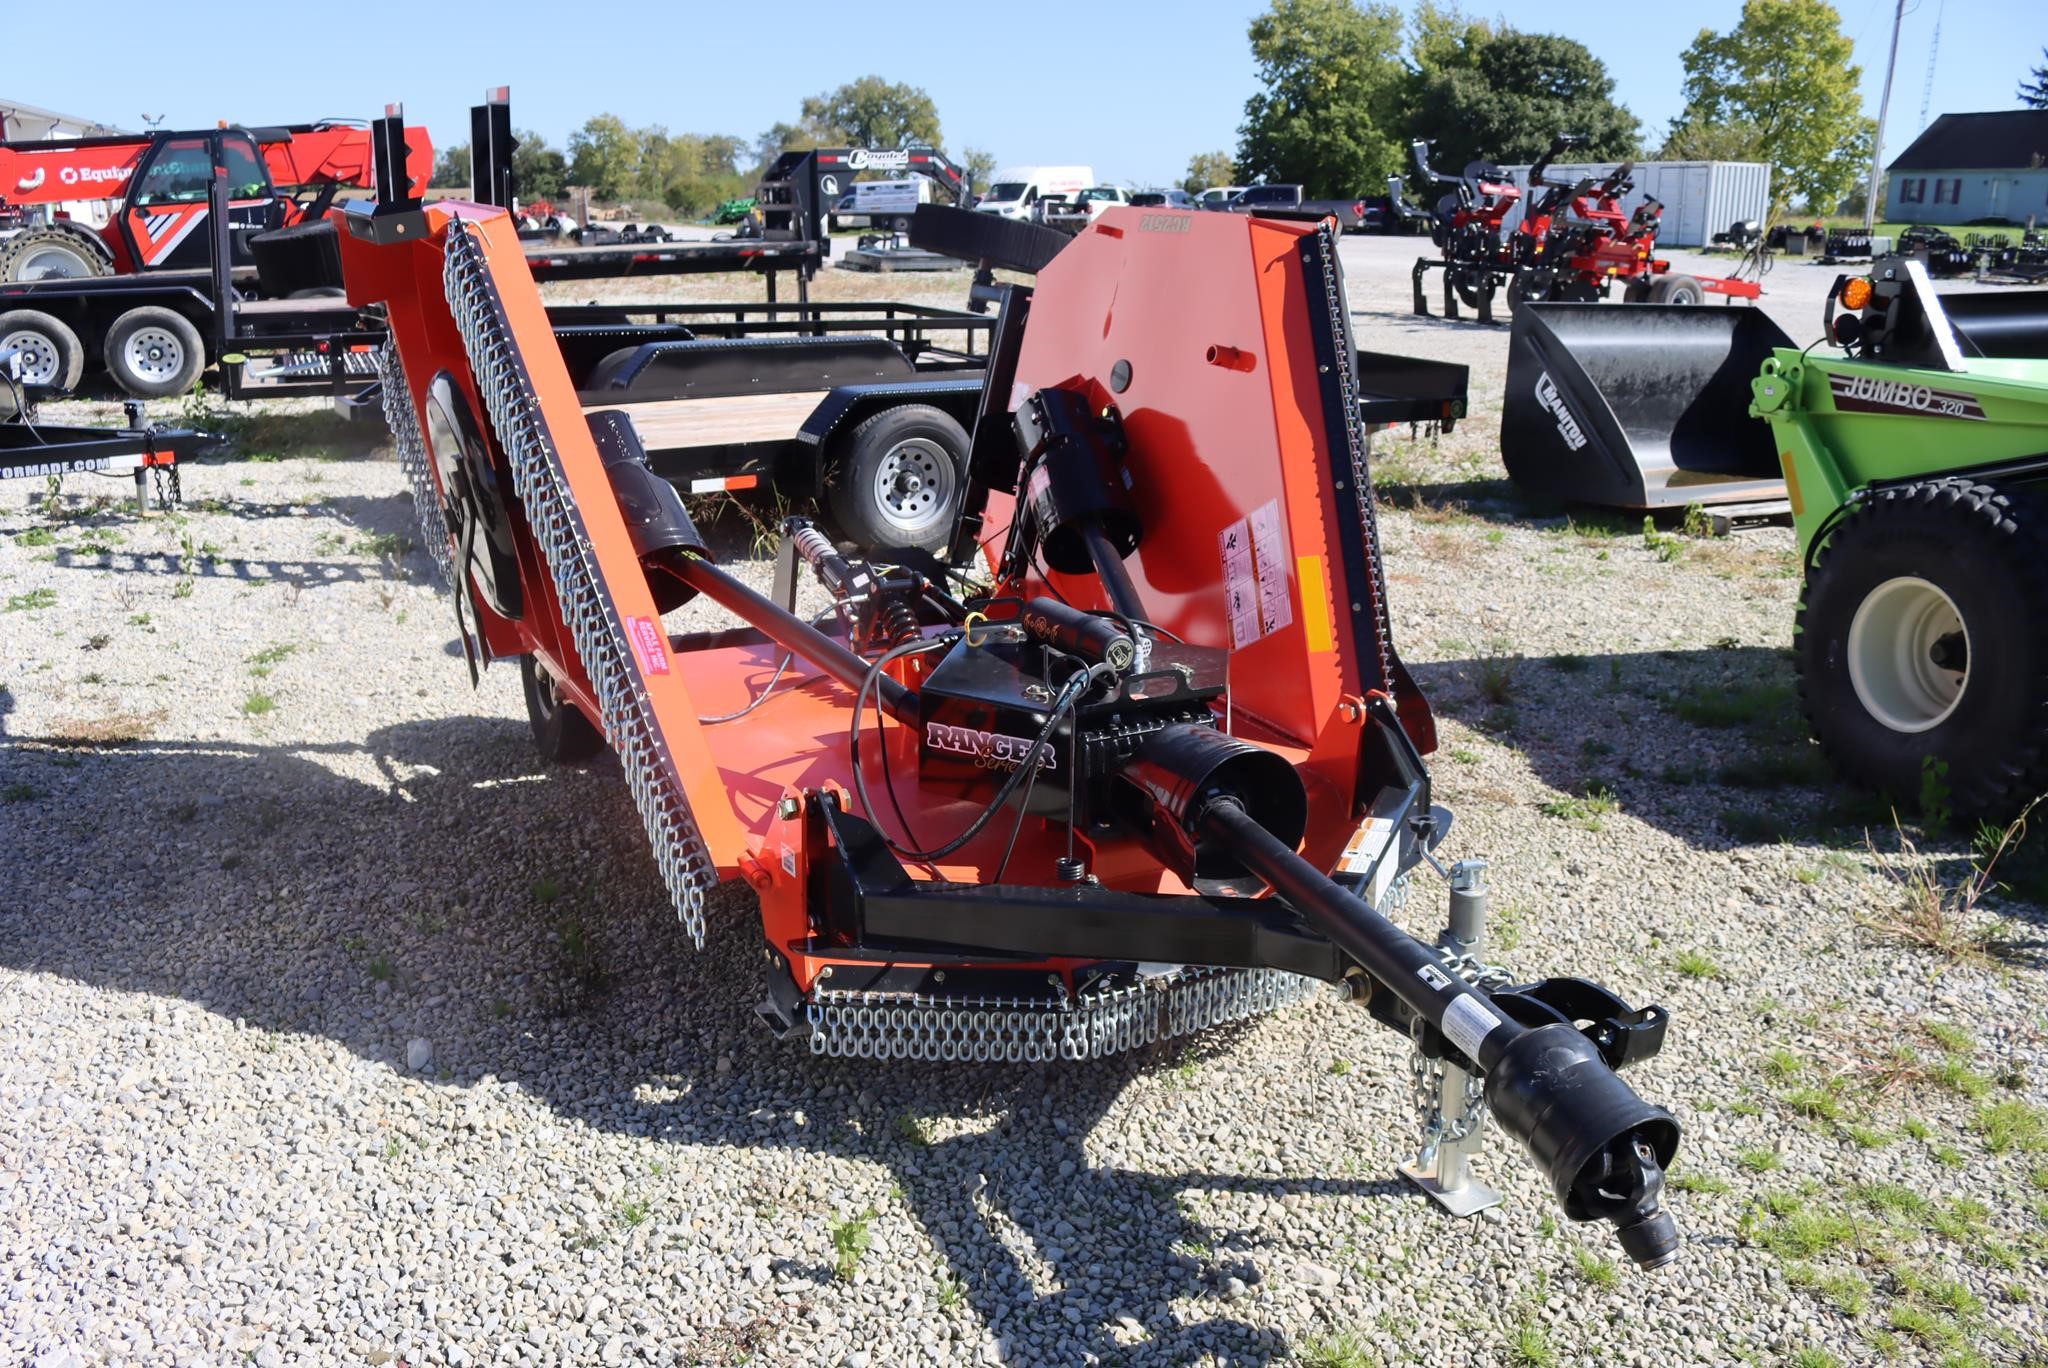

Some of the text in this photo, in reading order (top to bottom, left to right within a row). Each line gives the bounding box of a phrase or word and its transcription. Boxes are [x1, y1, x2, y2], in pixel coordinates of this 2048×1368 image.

[1542, 385, 1587, 448] MANITOU
[1844, 375, 1964, 417] JUMBO 320
[1557, 423, 1577, 451] GROUP
[0, 458, 110, 480] ORMADE.COM
[927, 722, 1057, 769] RANGER
